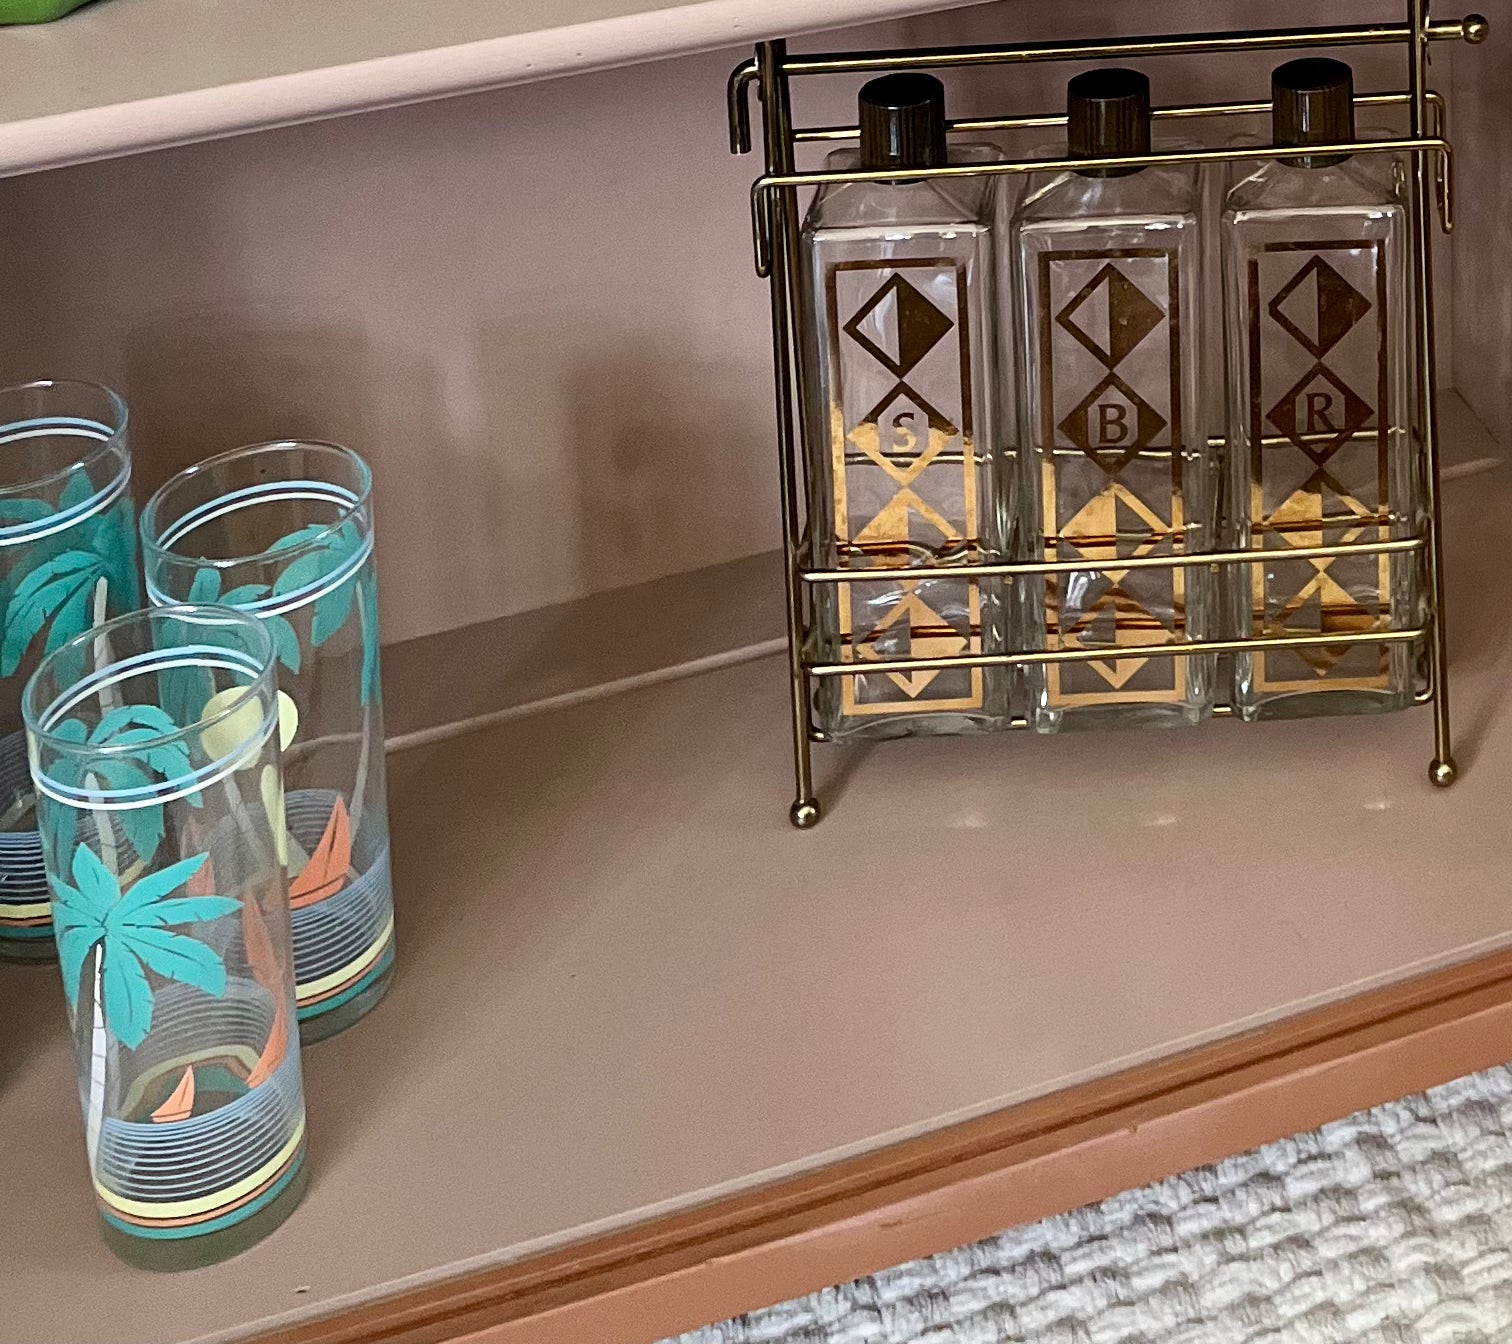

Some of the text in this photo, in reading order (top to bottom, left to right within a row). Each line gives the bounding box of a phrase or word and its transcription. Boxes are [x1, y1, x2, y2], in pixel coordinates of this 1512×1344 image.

[890, 412, 917, 453] S
[1098, 403, 1128, 445] B
[1306, 392, 1335, 433] R
